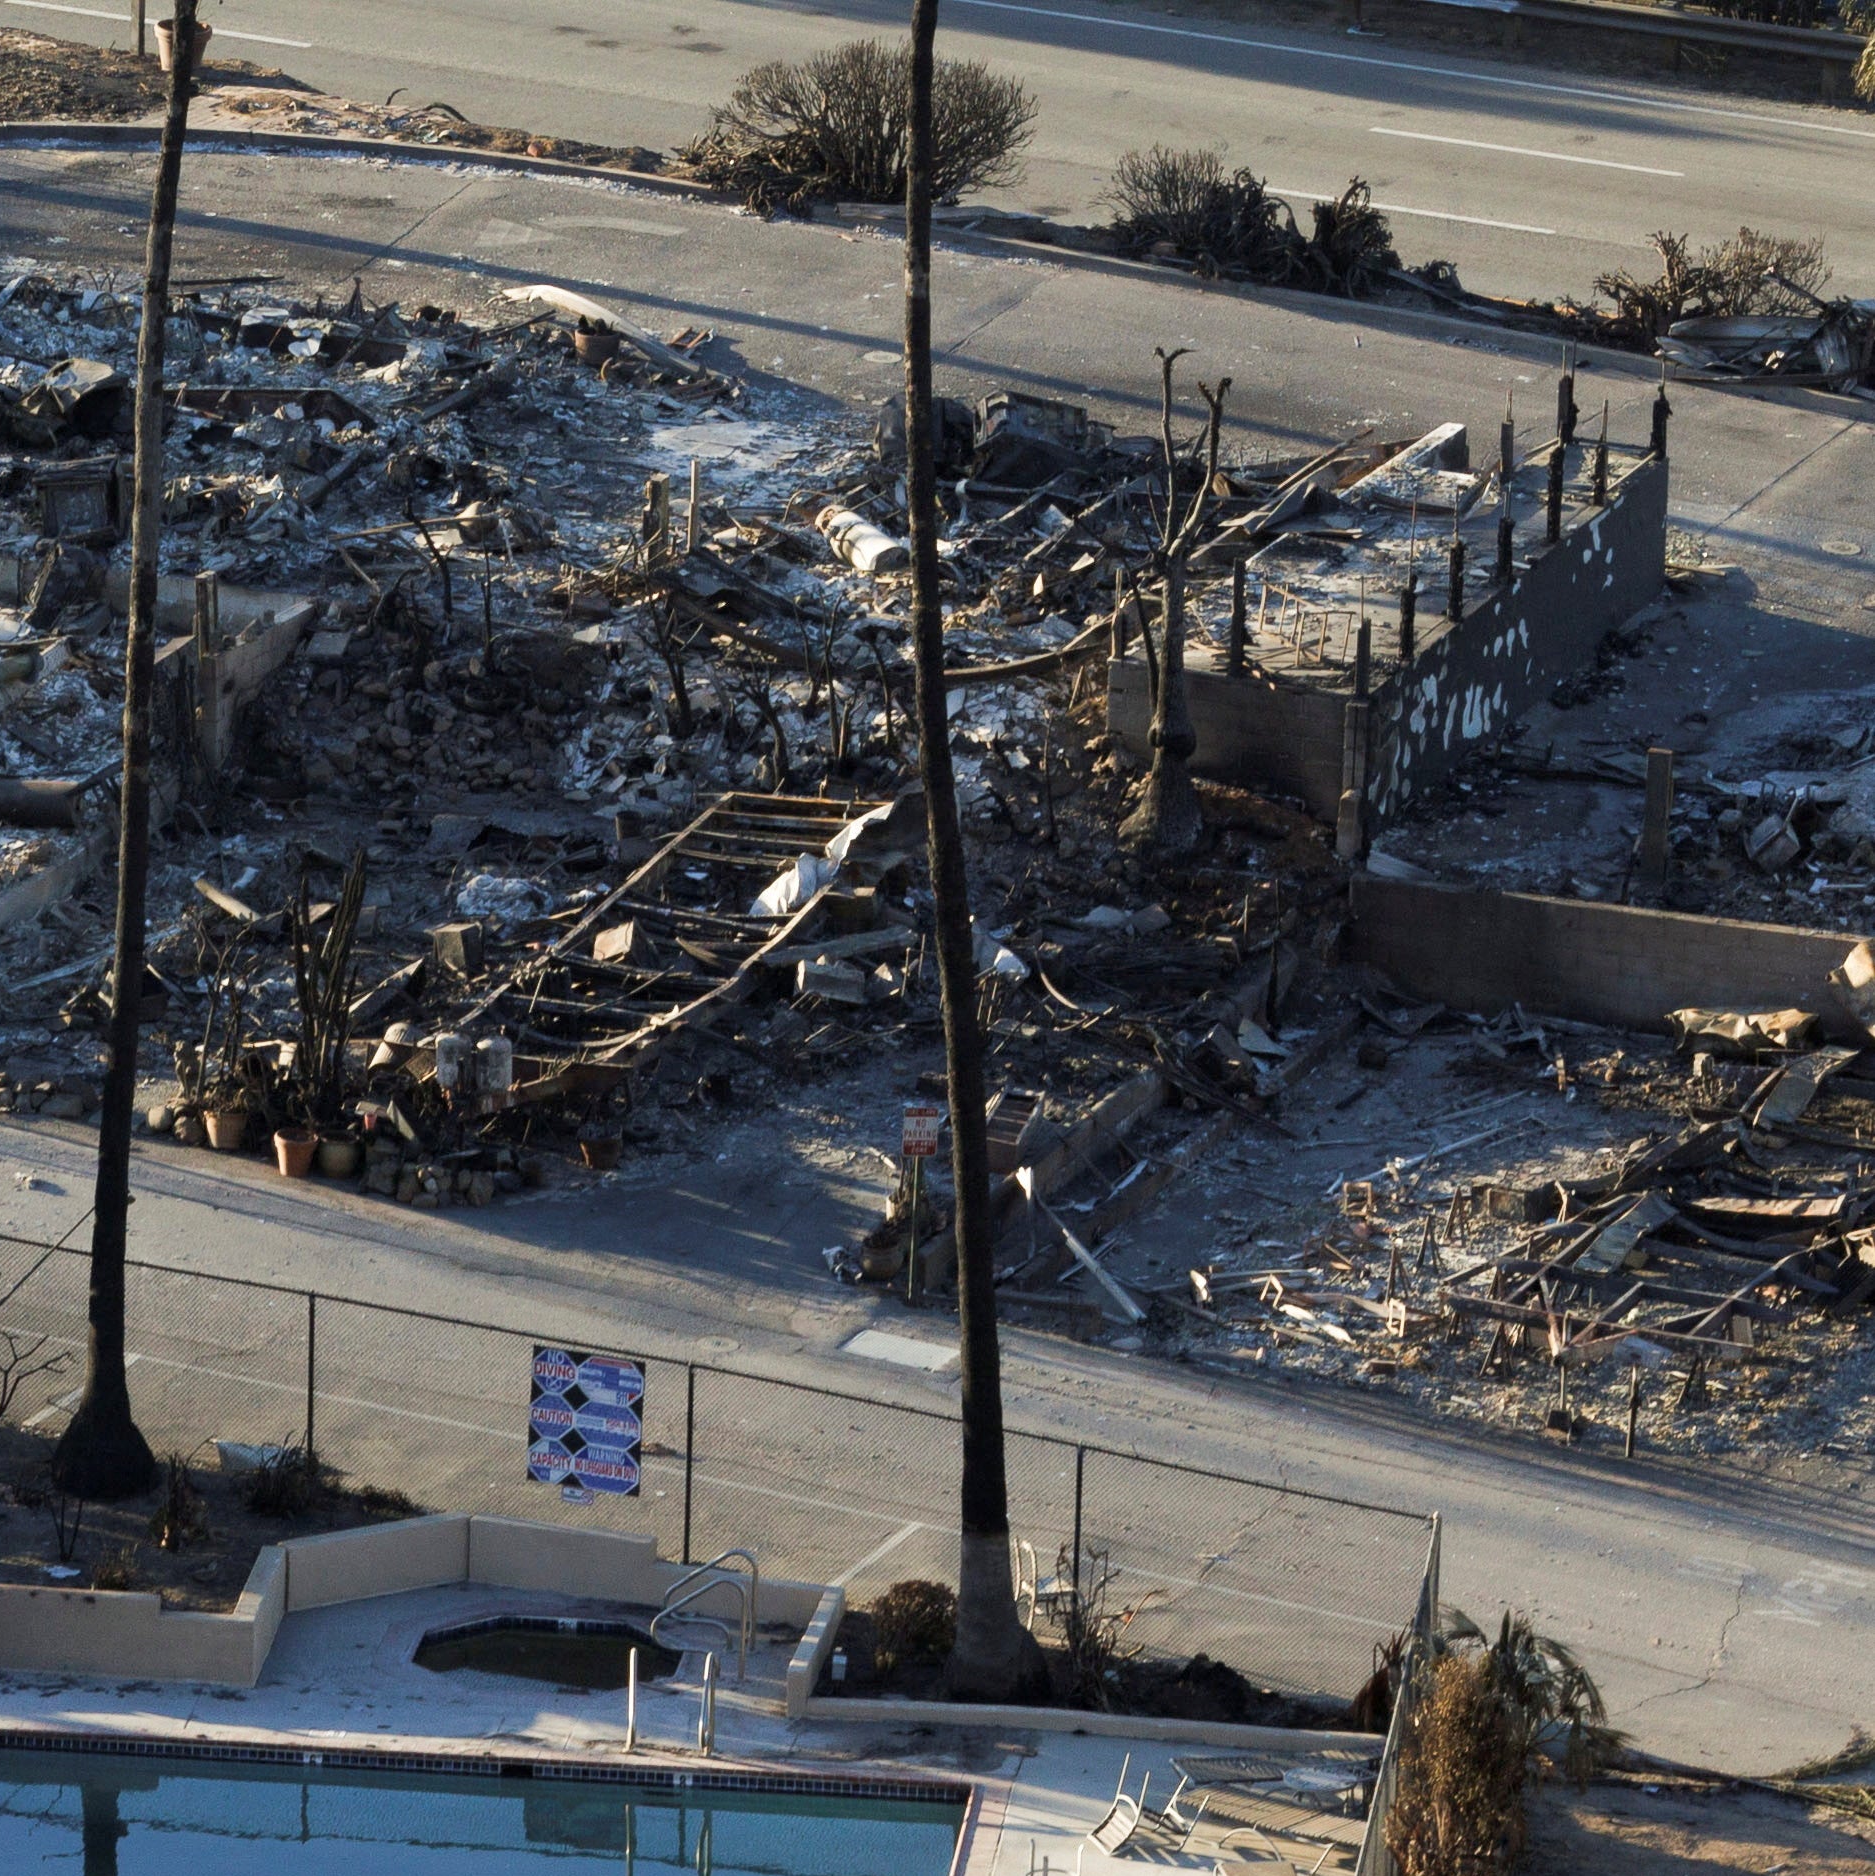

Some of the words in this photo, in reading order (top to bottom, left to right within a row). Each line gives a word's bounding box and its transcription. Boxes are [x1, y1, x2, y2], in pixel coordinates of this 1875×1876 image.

[915, 1119, 927, 1128] NO
[547, 1349, 564, 1364] NO
[534, 1361, 576, 1379] DIVING
[531, 1408, 573, 1426] CAUTION
[530, 1452, 572, 1471] CAPACITY
[589, 1448, 626, 1464] WARNING
[574, 1458, 583, 1469] NO
[584, 1460, 613, 1476] LIFEGUARD
[614, 1465, 623, 1477] ON
